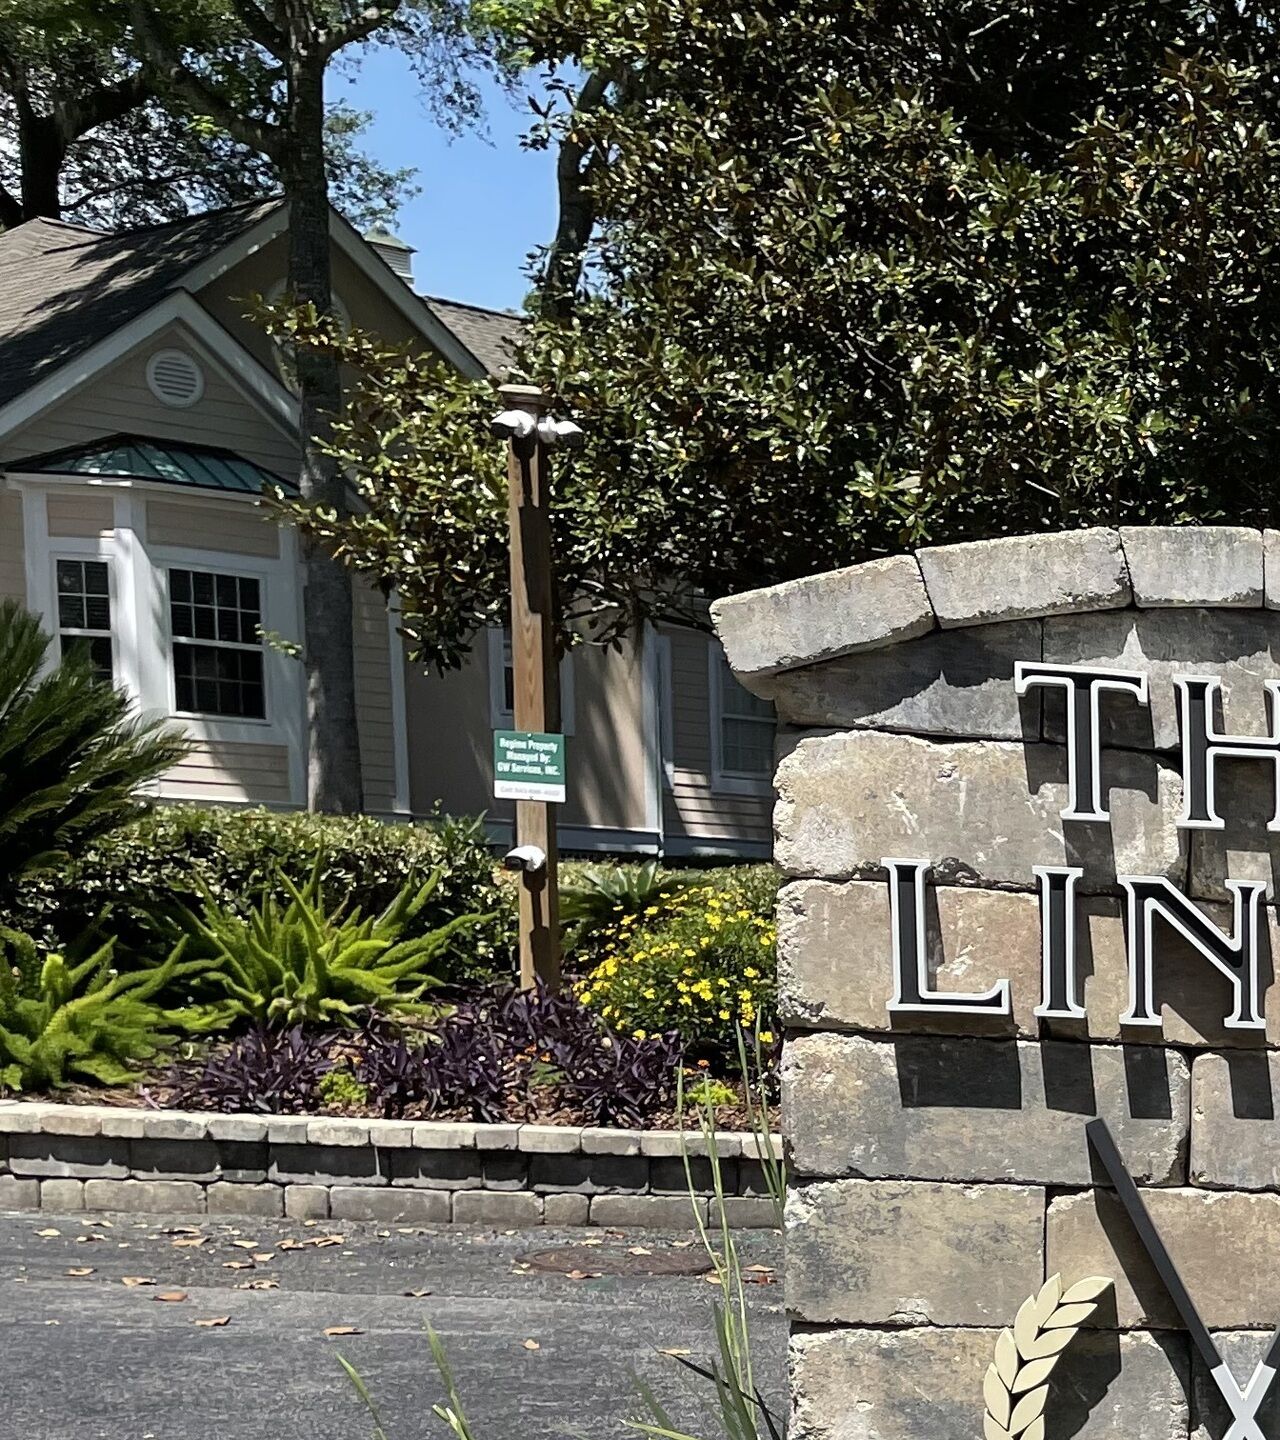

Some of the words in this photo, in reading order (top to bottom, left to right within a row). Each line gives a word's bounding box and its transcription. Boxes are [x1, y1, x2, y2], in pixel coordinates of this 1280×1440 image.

[528, 740, 558, 753] Property
[506, 750, 539, 764] Managed
[511, 762, 545, 775] Services,
